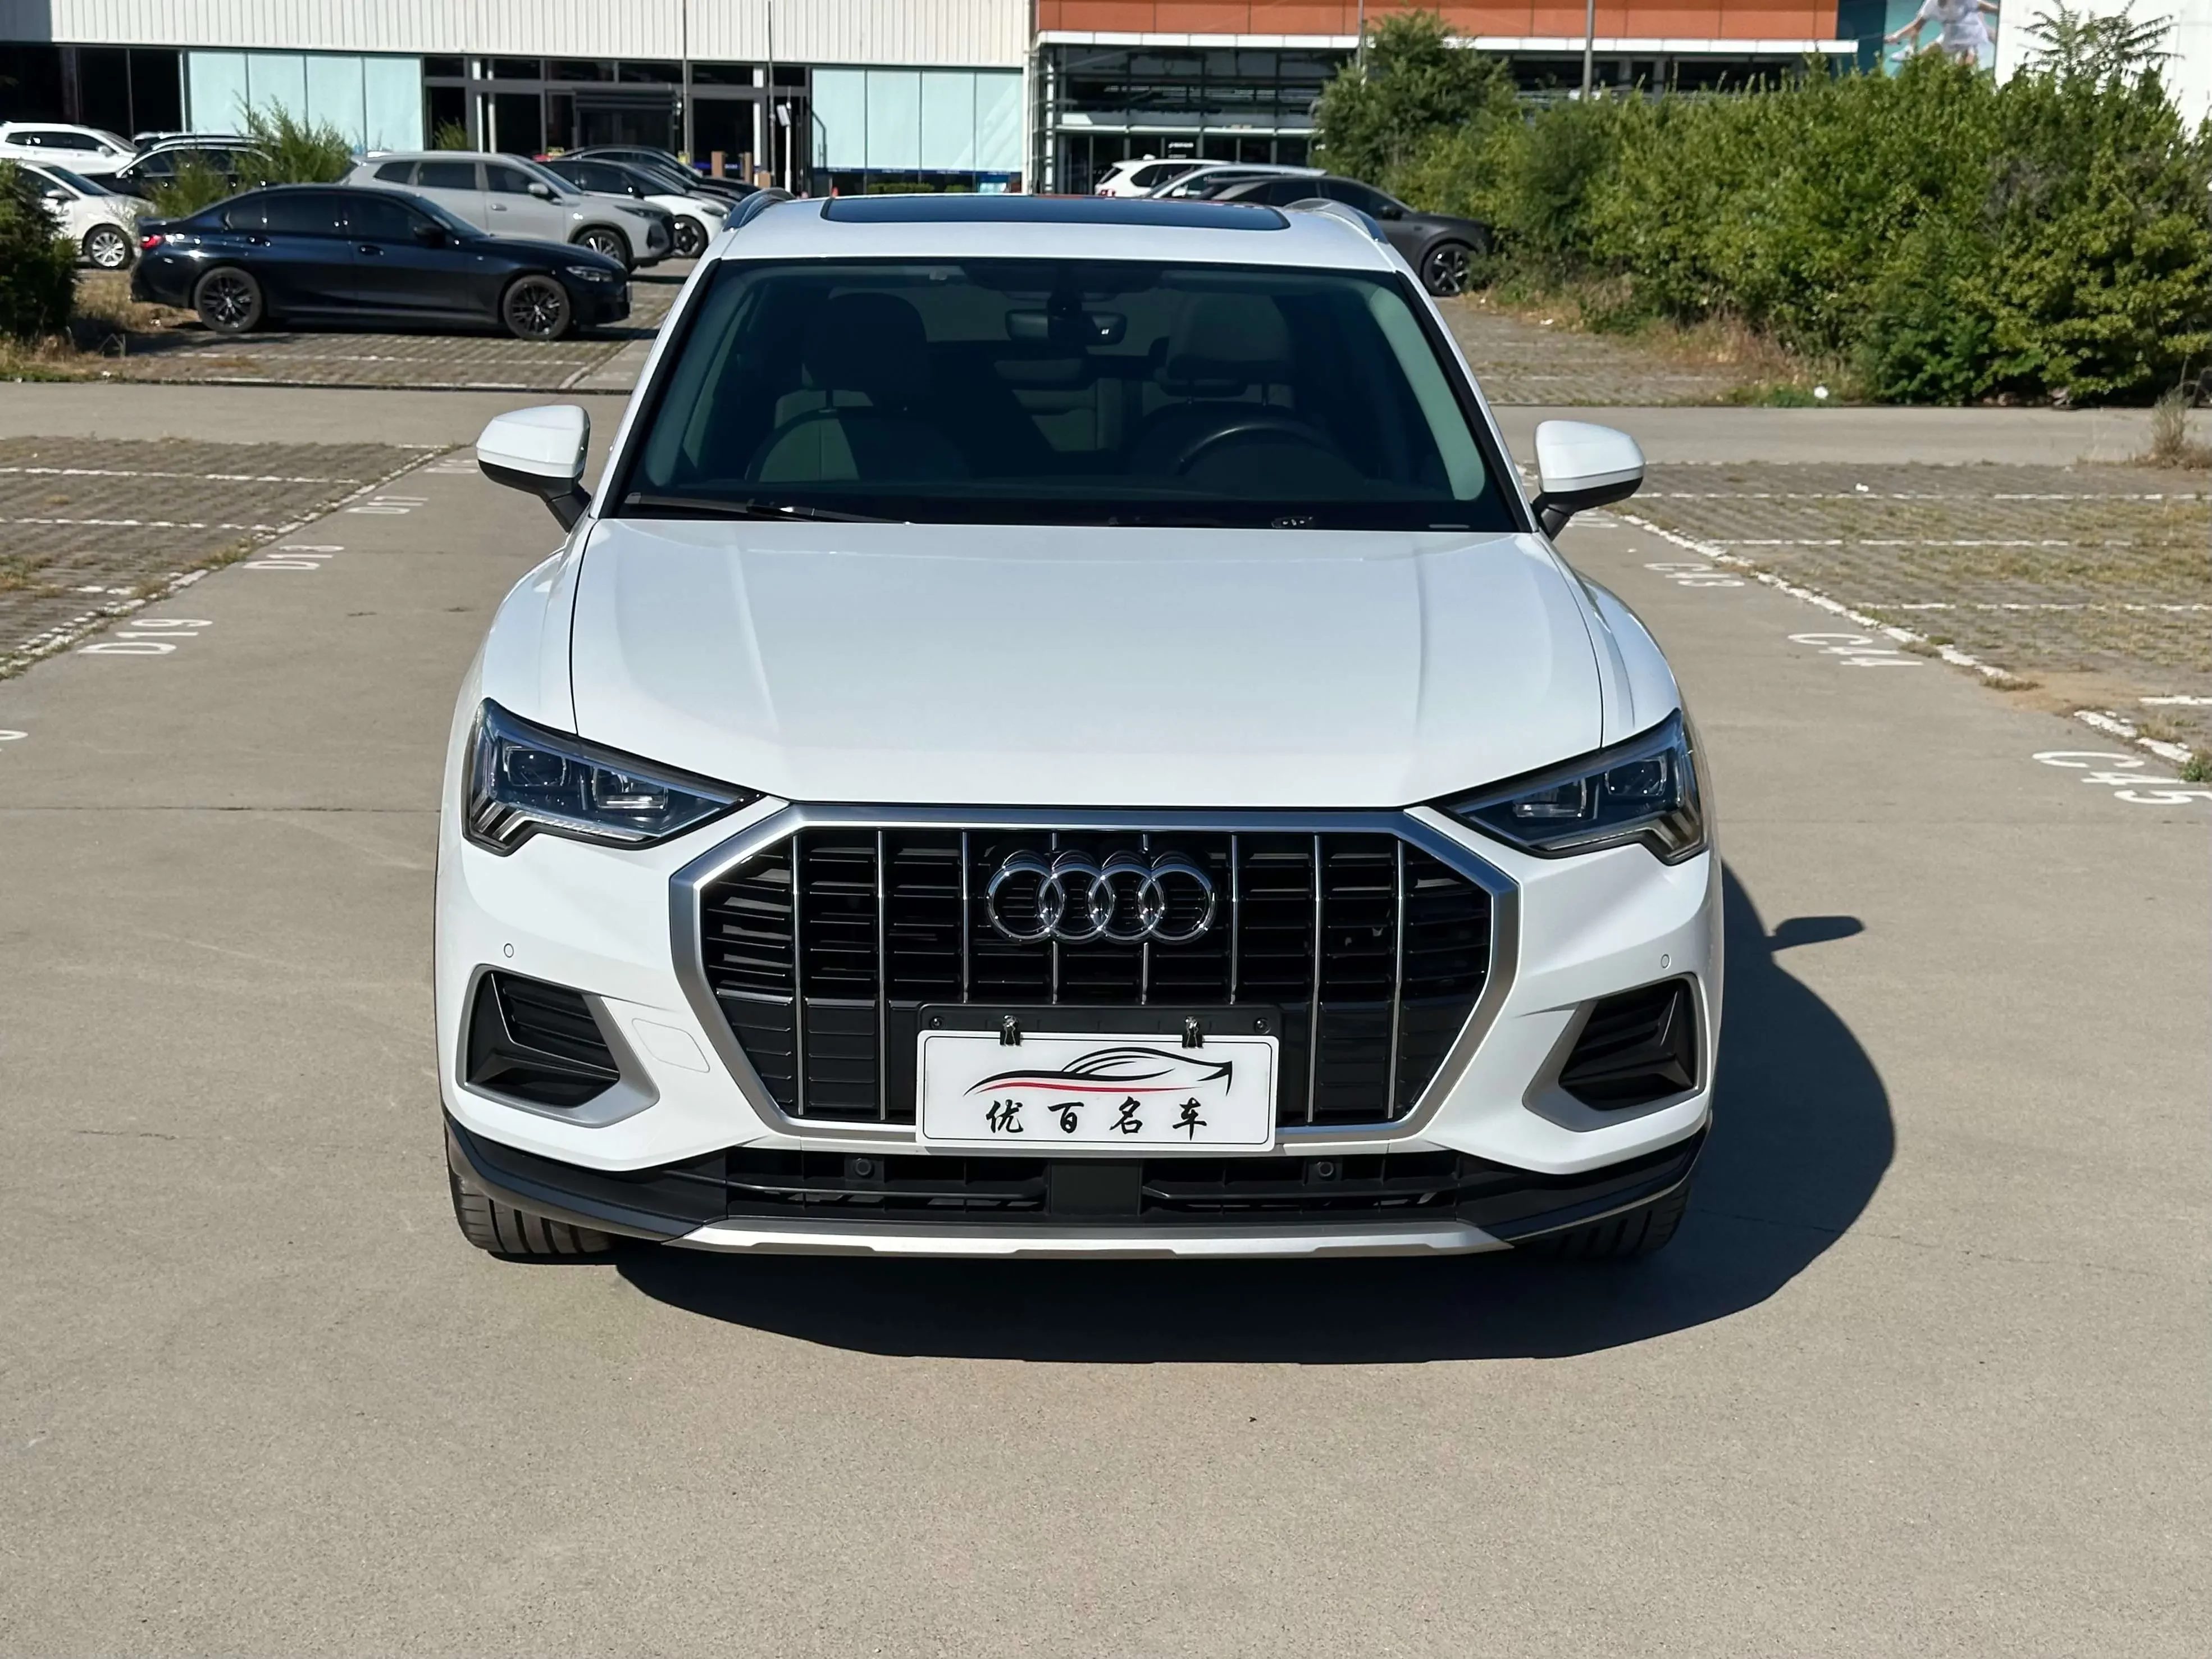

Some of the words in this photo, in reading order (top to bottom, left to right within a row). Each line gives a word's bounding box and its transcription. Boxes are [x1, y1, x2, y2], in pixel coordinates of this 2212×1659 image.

[1643, 562, 1745, 586] C43
[76, 618, 213, 654] D19
[1787, 633, 1924, 667] C44
[2032, 751, 2212, 805] C45
[986, 1096, 1207, 1141] 优百名车
